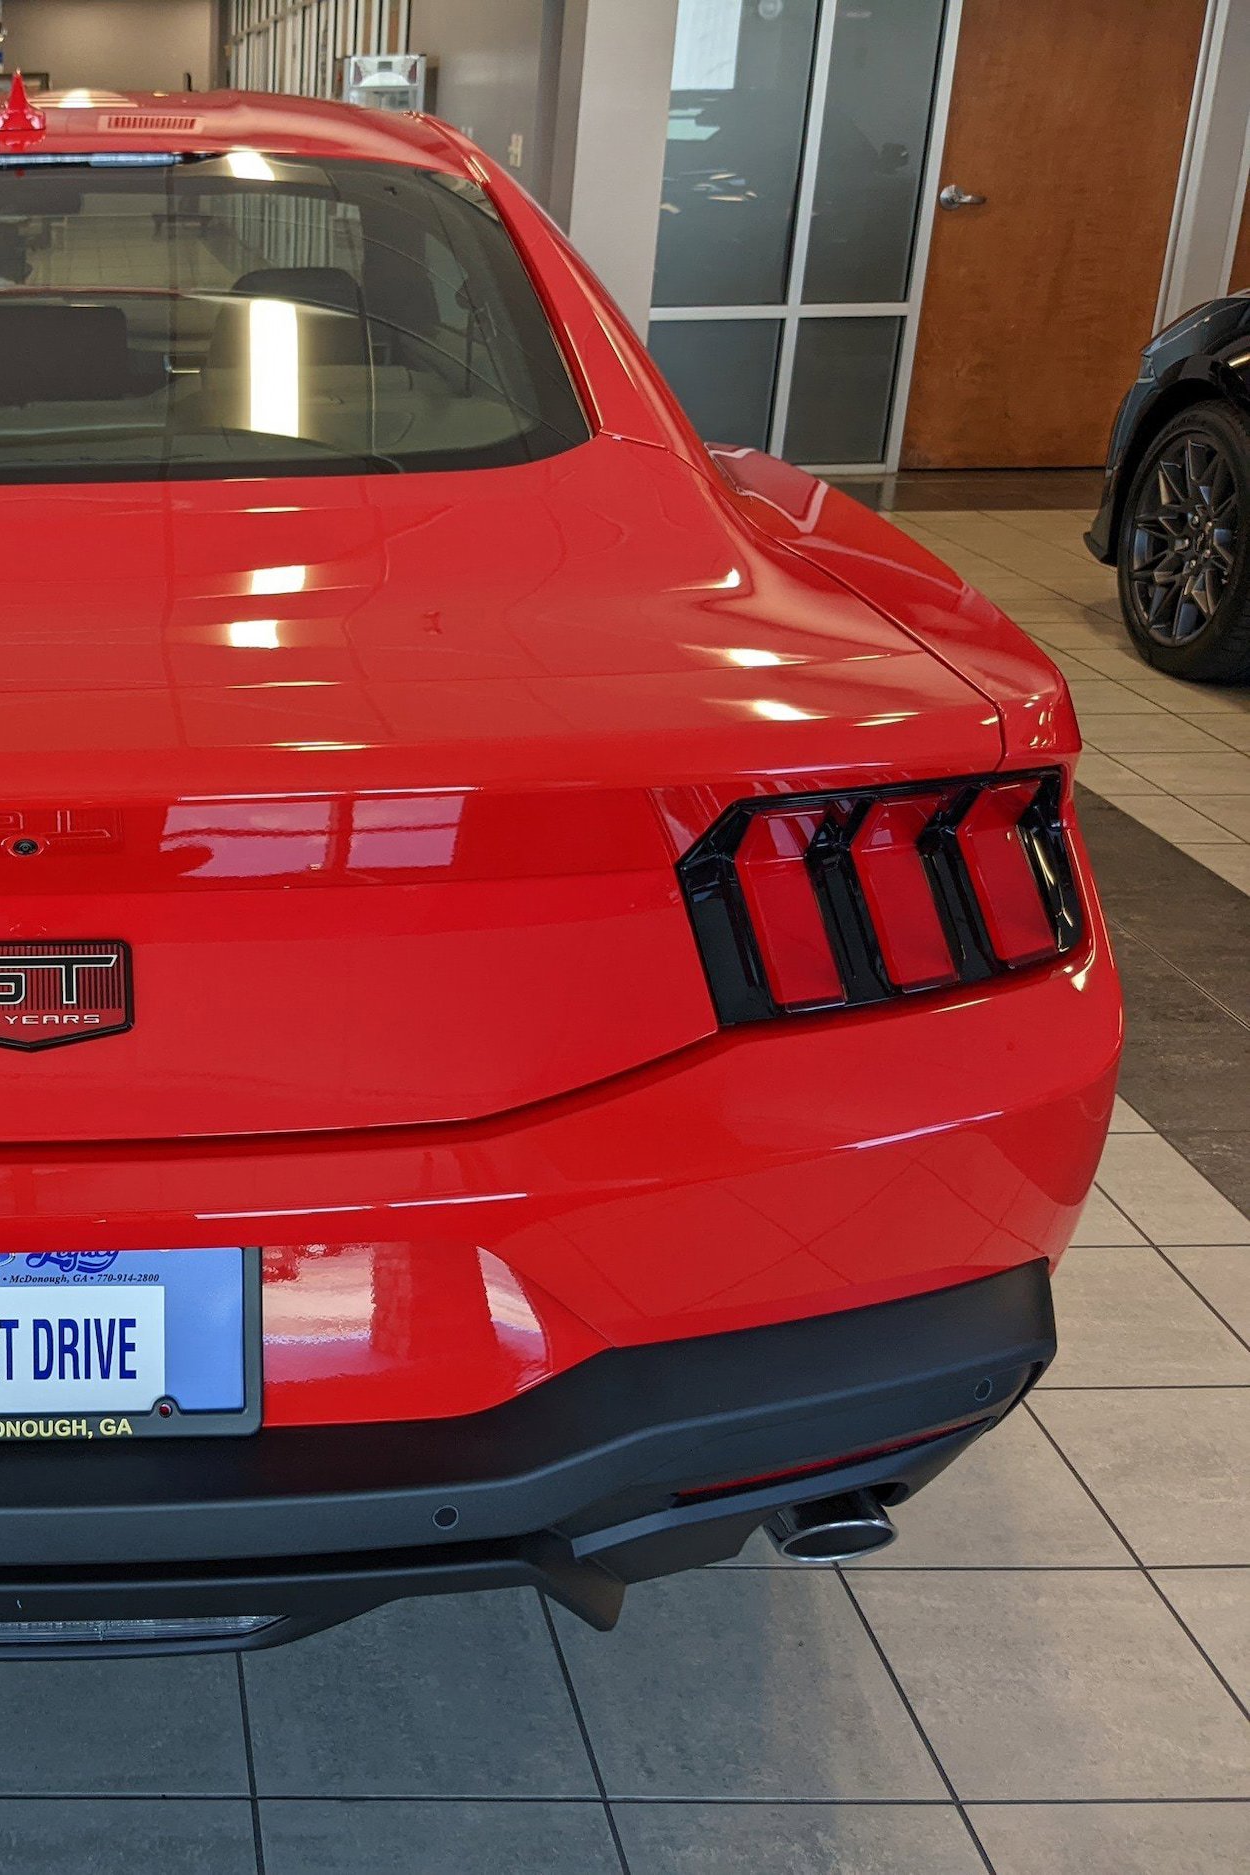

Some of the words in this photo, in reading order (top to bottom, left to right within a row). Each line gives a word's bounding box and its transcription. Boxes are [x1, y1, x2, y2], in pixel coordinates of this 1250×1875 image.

[5, 1014, 100, 1025] YEARS
[9, 1274, 70, 1285] McDonough,
[72, 1274, 88, 1283] GA
[97, 1273, 160, 1283] 770-914-2800
[32, 1318, 138, 1380] DRIVE
[99, 1418, 133, 1435] GA
